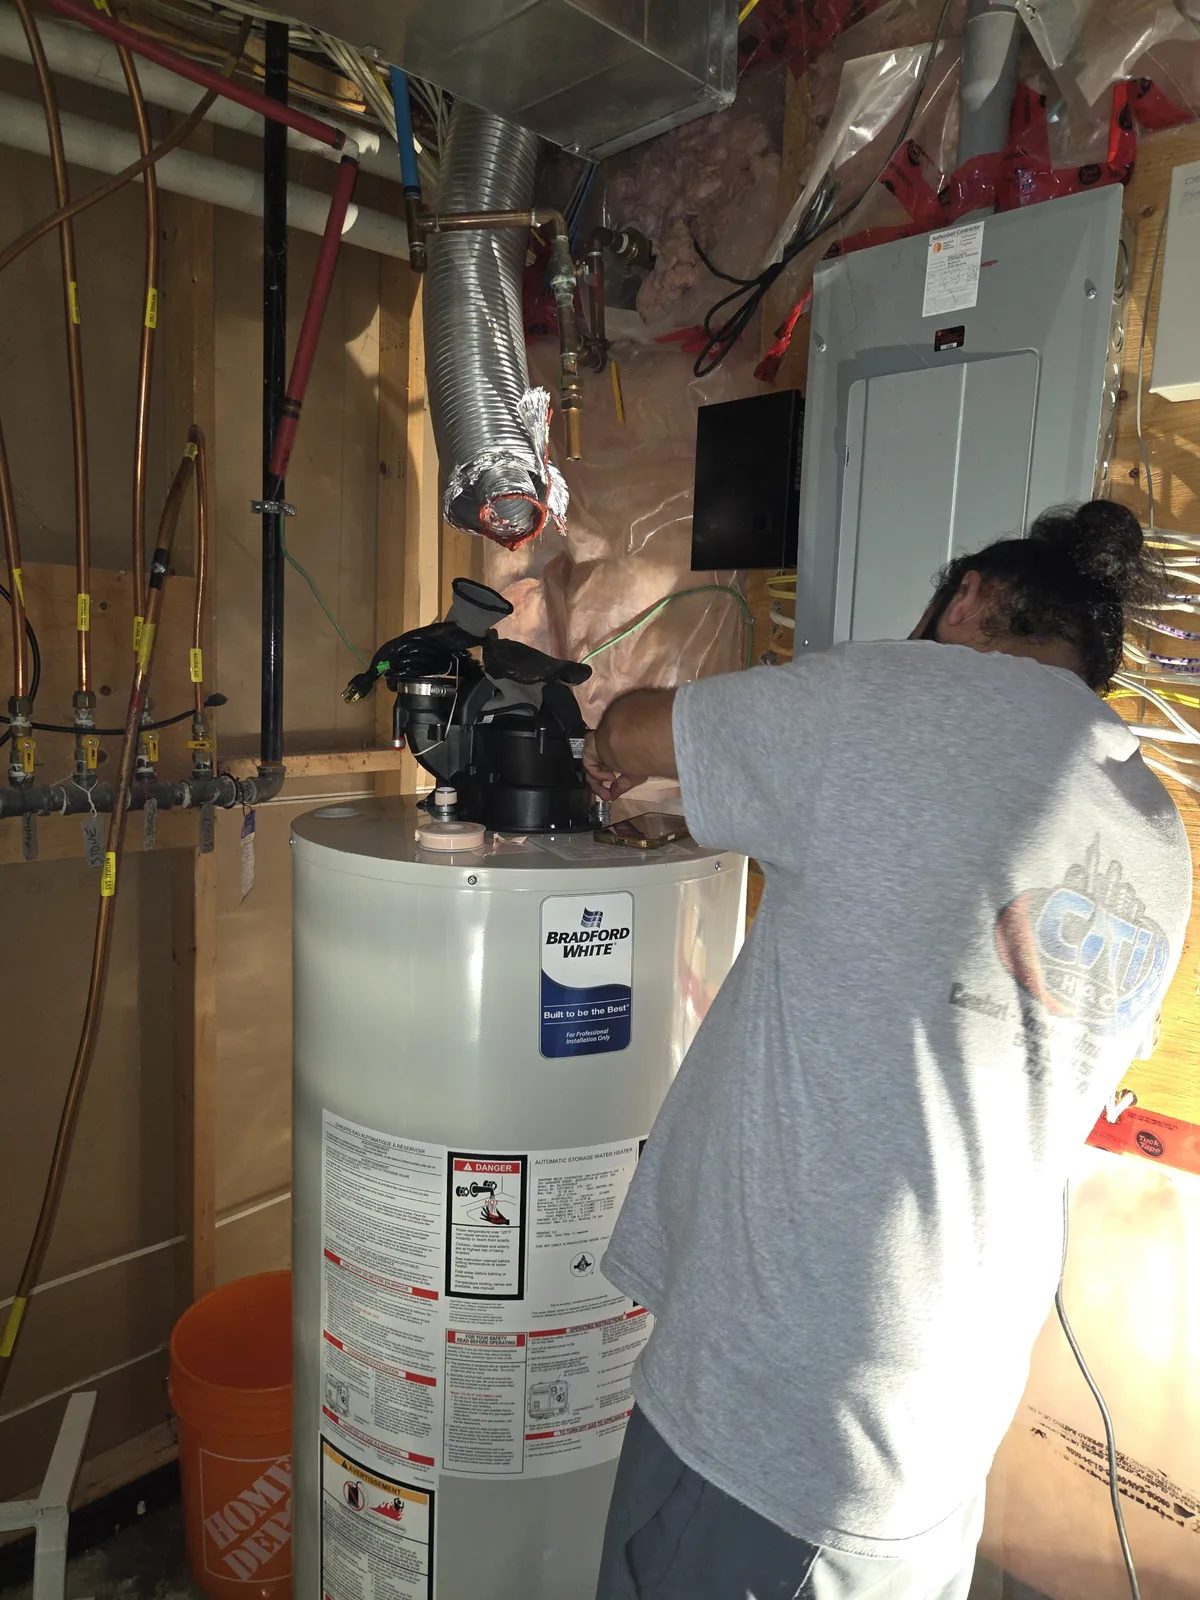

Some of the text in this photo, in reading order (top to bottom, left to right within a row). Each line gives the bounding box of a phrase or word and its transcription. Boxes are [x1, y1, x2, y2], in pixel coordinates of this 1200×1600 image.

[932, 231, 955, 241] Authorized
[957, 225, 981, 234] Contractor
[546, 927, 630, 945] BRADFORD
[544, 1008, 564, 1019] Built
[577, 1009, 589, 1017] be
[591, 1007, 605, 1015] the
[576, 1028, 609, 1037] Professional
[597, 1034, 610, 1042] Only
[361, 1133, 392, 1146] AUTOMATIQUE
[397, 1143, 425, 1154] RÉSERVOIR
[1139, 1134, 1159, 1147] Tuck
[1139, 1142, 1161, 1153] Tape
[568, 1155, 593, 1163] STORAGE
[614, 1147, 632, 1155] HEATER
[475, 1164, 512, 1172] DANGER
[569, 1323, 594, 1333] OPERATING
[567, 1427, 579, 1435] TURN
[348, 1465, 401, 1495] AVERTISSEMENT
[204, 1456, 292, 1549] HOME
[222, 1498, 292, 1581] DEP
